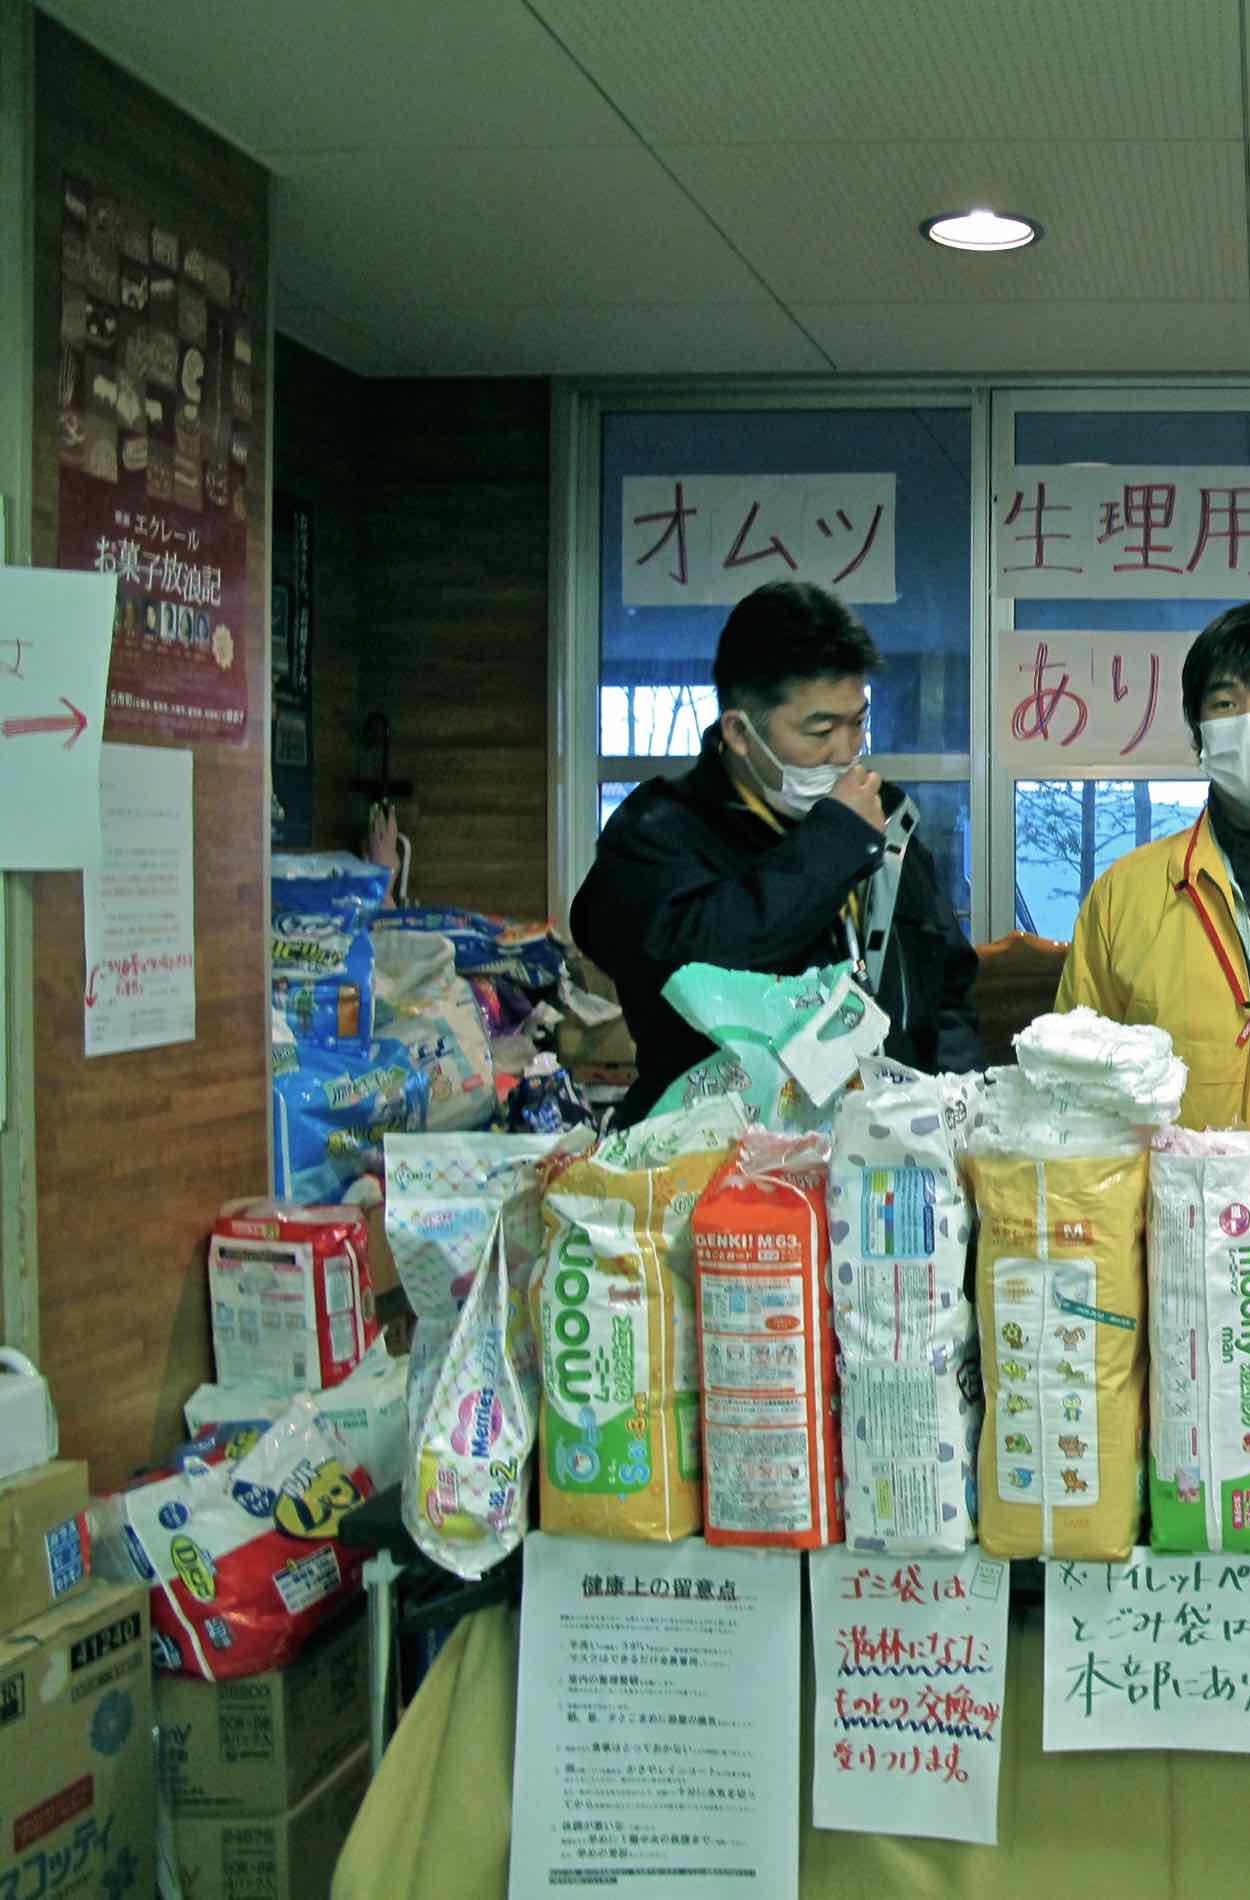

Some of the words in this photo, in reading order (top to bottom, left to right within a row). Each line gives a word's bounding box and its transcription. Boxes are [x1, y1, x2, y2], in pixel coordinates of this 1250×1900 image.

[633, 482, 883, 583] オムツ
[1063, 1224, 1084, 1240] M
[1220, 1326, 1235, 1365] man
[582, 1573, 738, 1602] 健康上の留意点
